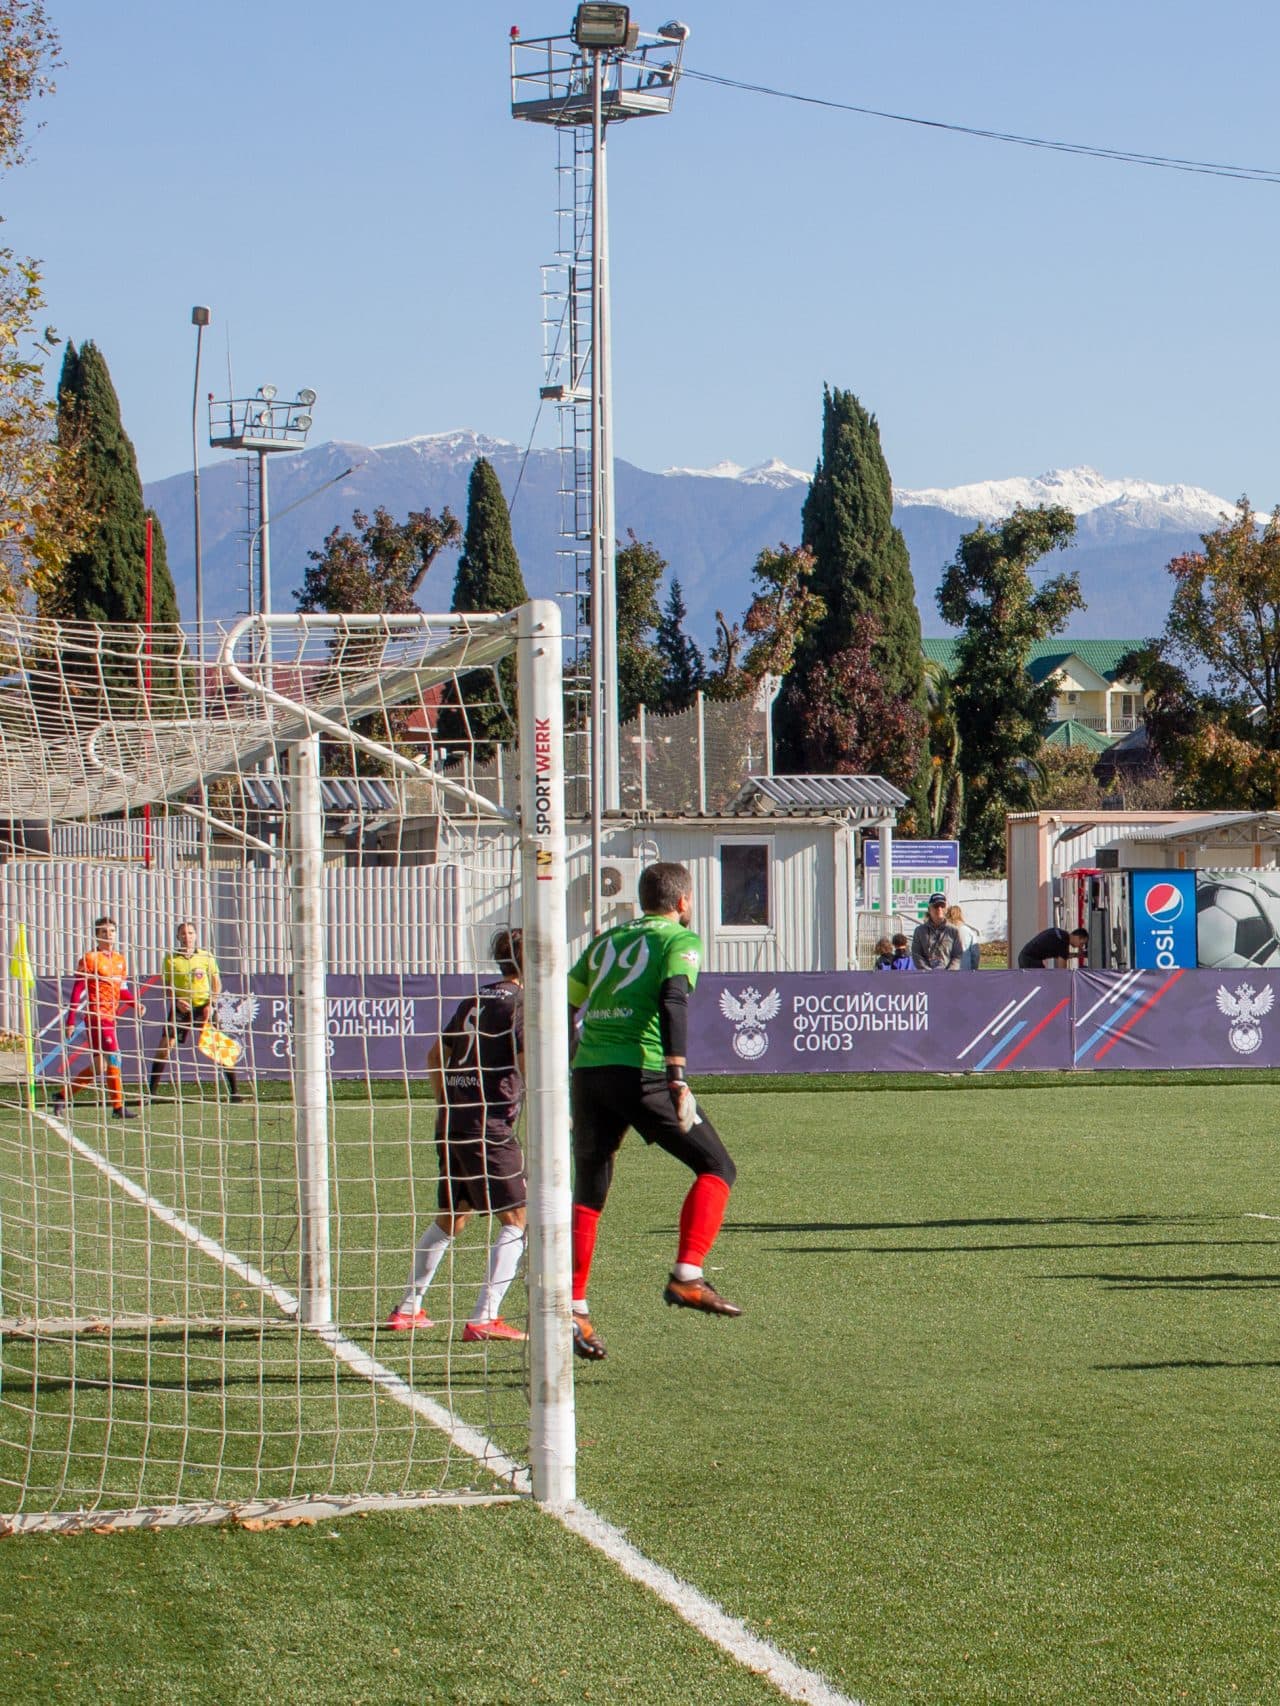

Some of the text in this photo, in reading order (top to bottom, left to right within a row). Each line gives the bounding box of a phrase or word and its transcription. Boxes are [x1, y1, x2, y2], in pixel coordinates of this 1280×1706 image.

[1151, 925, 1180, 970] psi
[589, 935, 650, 999] 99
[793, 991, 929, 1013] РОССИЙСКИЙ
[793, 1011, 929, 1032] ФУТБОЛЬНЫЙ
[793, 1033, 853, 1051] СОЮЗ
